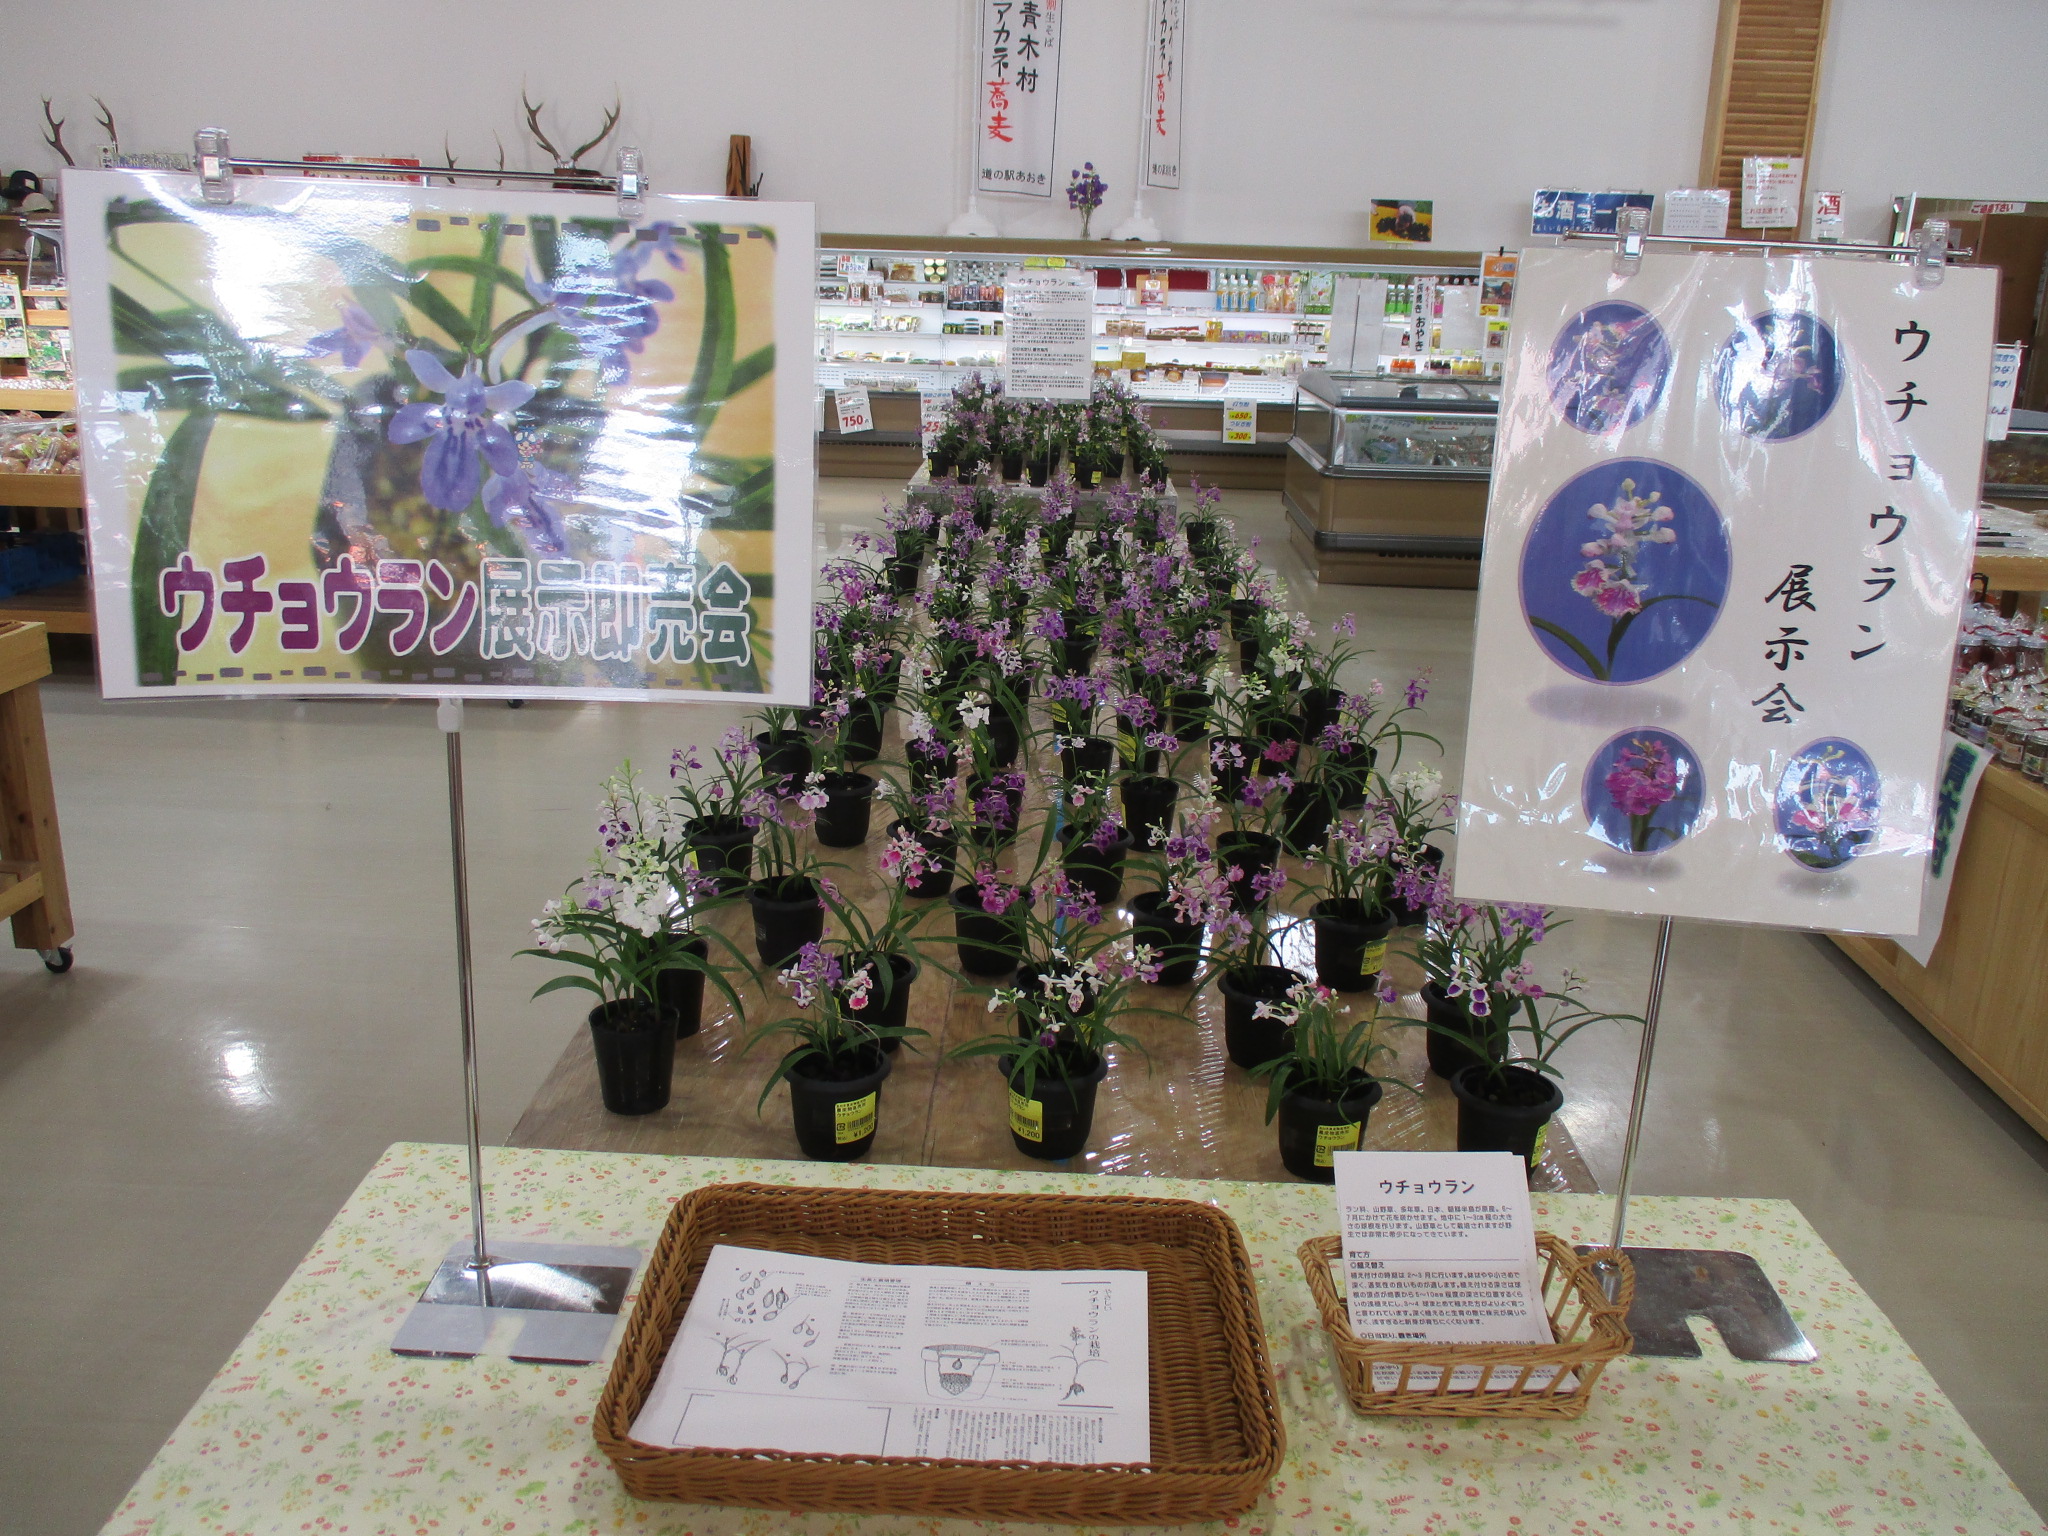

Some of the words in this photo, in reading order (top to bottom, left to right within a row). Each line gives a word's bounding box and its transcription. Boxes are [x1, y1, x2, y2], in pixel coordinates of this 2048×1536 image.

[985, 2, 1013, 143] アカネ蕎麦
[1016, 1, 1042, 93] 青木村
[981, 167, 1047, 185] 道の駅あおき
[1817, 195, 1841, 216] 酒
[1848, 320, 1931, 662] ウチョウラン
[159, 551, 752, 667] ウチョウラン展示即売会
[1750, 564, 1819, 725] 展示会
[1379, 1179, 1475, 1194] ウチョウラン
[1349, 1251, 1370, 1259] 育て方
[1088, 1289, 1100, 1357] ウチョウランの栽培
